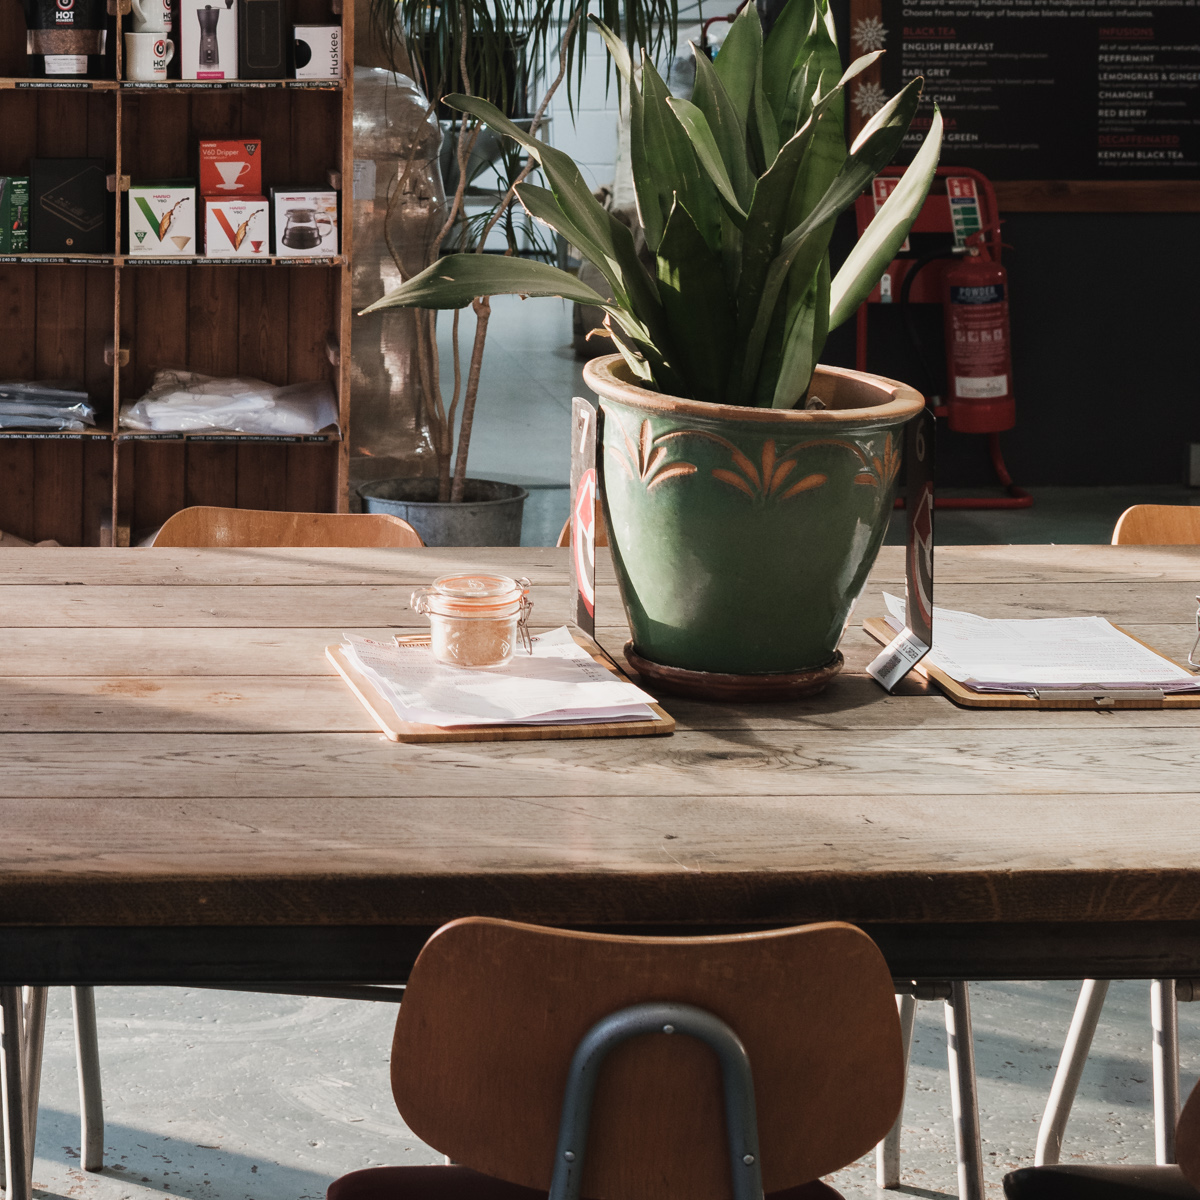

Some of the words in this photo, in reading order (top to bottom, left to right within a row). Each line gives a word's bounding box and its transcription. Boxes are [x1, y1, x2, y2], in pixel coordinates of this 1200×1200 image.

[903, 27, 935, 36] BLACK
[938, 27, 956, 36] TEA
[1098, 27, 1154, 38] INFUSIONS
[902, 43, 942, 51] ENGLISH
[943, 43, 994, 51] BREAKFAST
[330, 30, 339, 76] Huskee.
[1098, 54, 1154, 62] PEPPERMINT
[902, 68, 925, 77] EARL
[926, 68, 950, 77] GREY
[1098, 72, 1159, 81] LEMONGRASS
[1098, 91, 1154, 99] CHAMOMILE
[1097, 109, 1117, 117] RED
[1118, 109, 1147, 117] BERRY
[947, 133, 979, 142] GREEN
[1098, 135, 1180, 146] DECAFFEINATED
[1136, 151, 1165, 159] BLACK
[1167, 151, 1184, 159] TEA
[960, 286, 995, 296] POWDER
[580, 409, 590, 453] 7
[916, 418, 926, 462] 6
